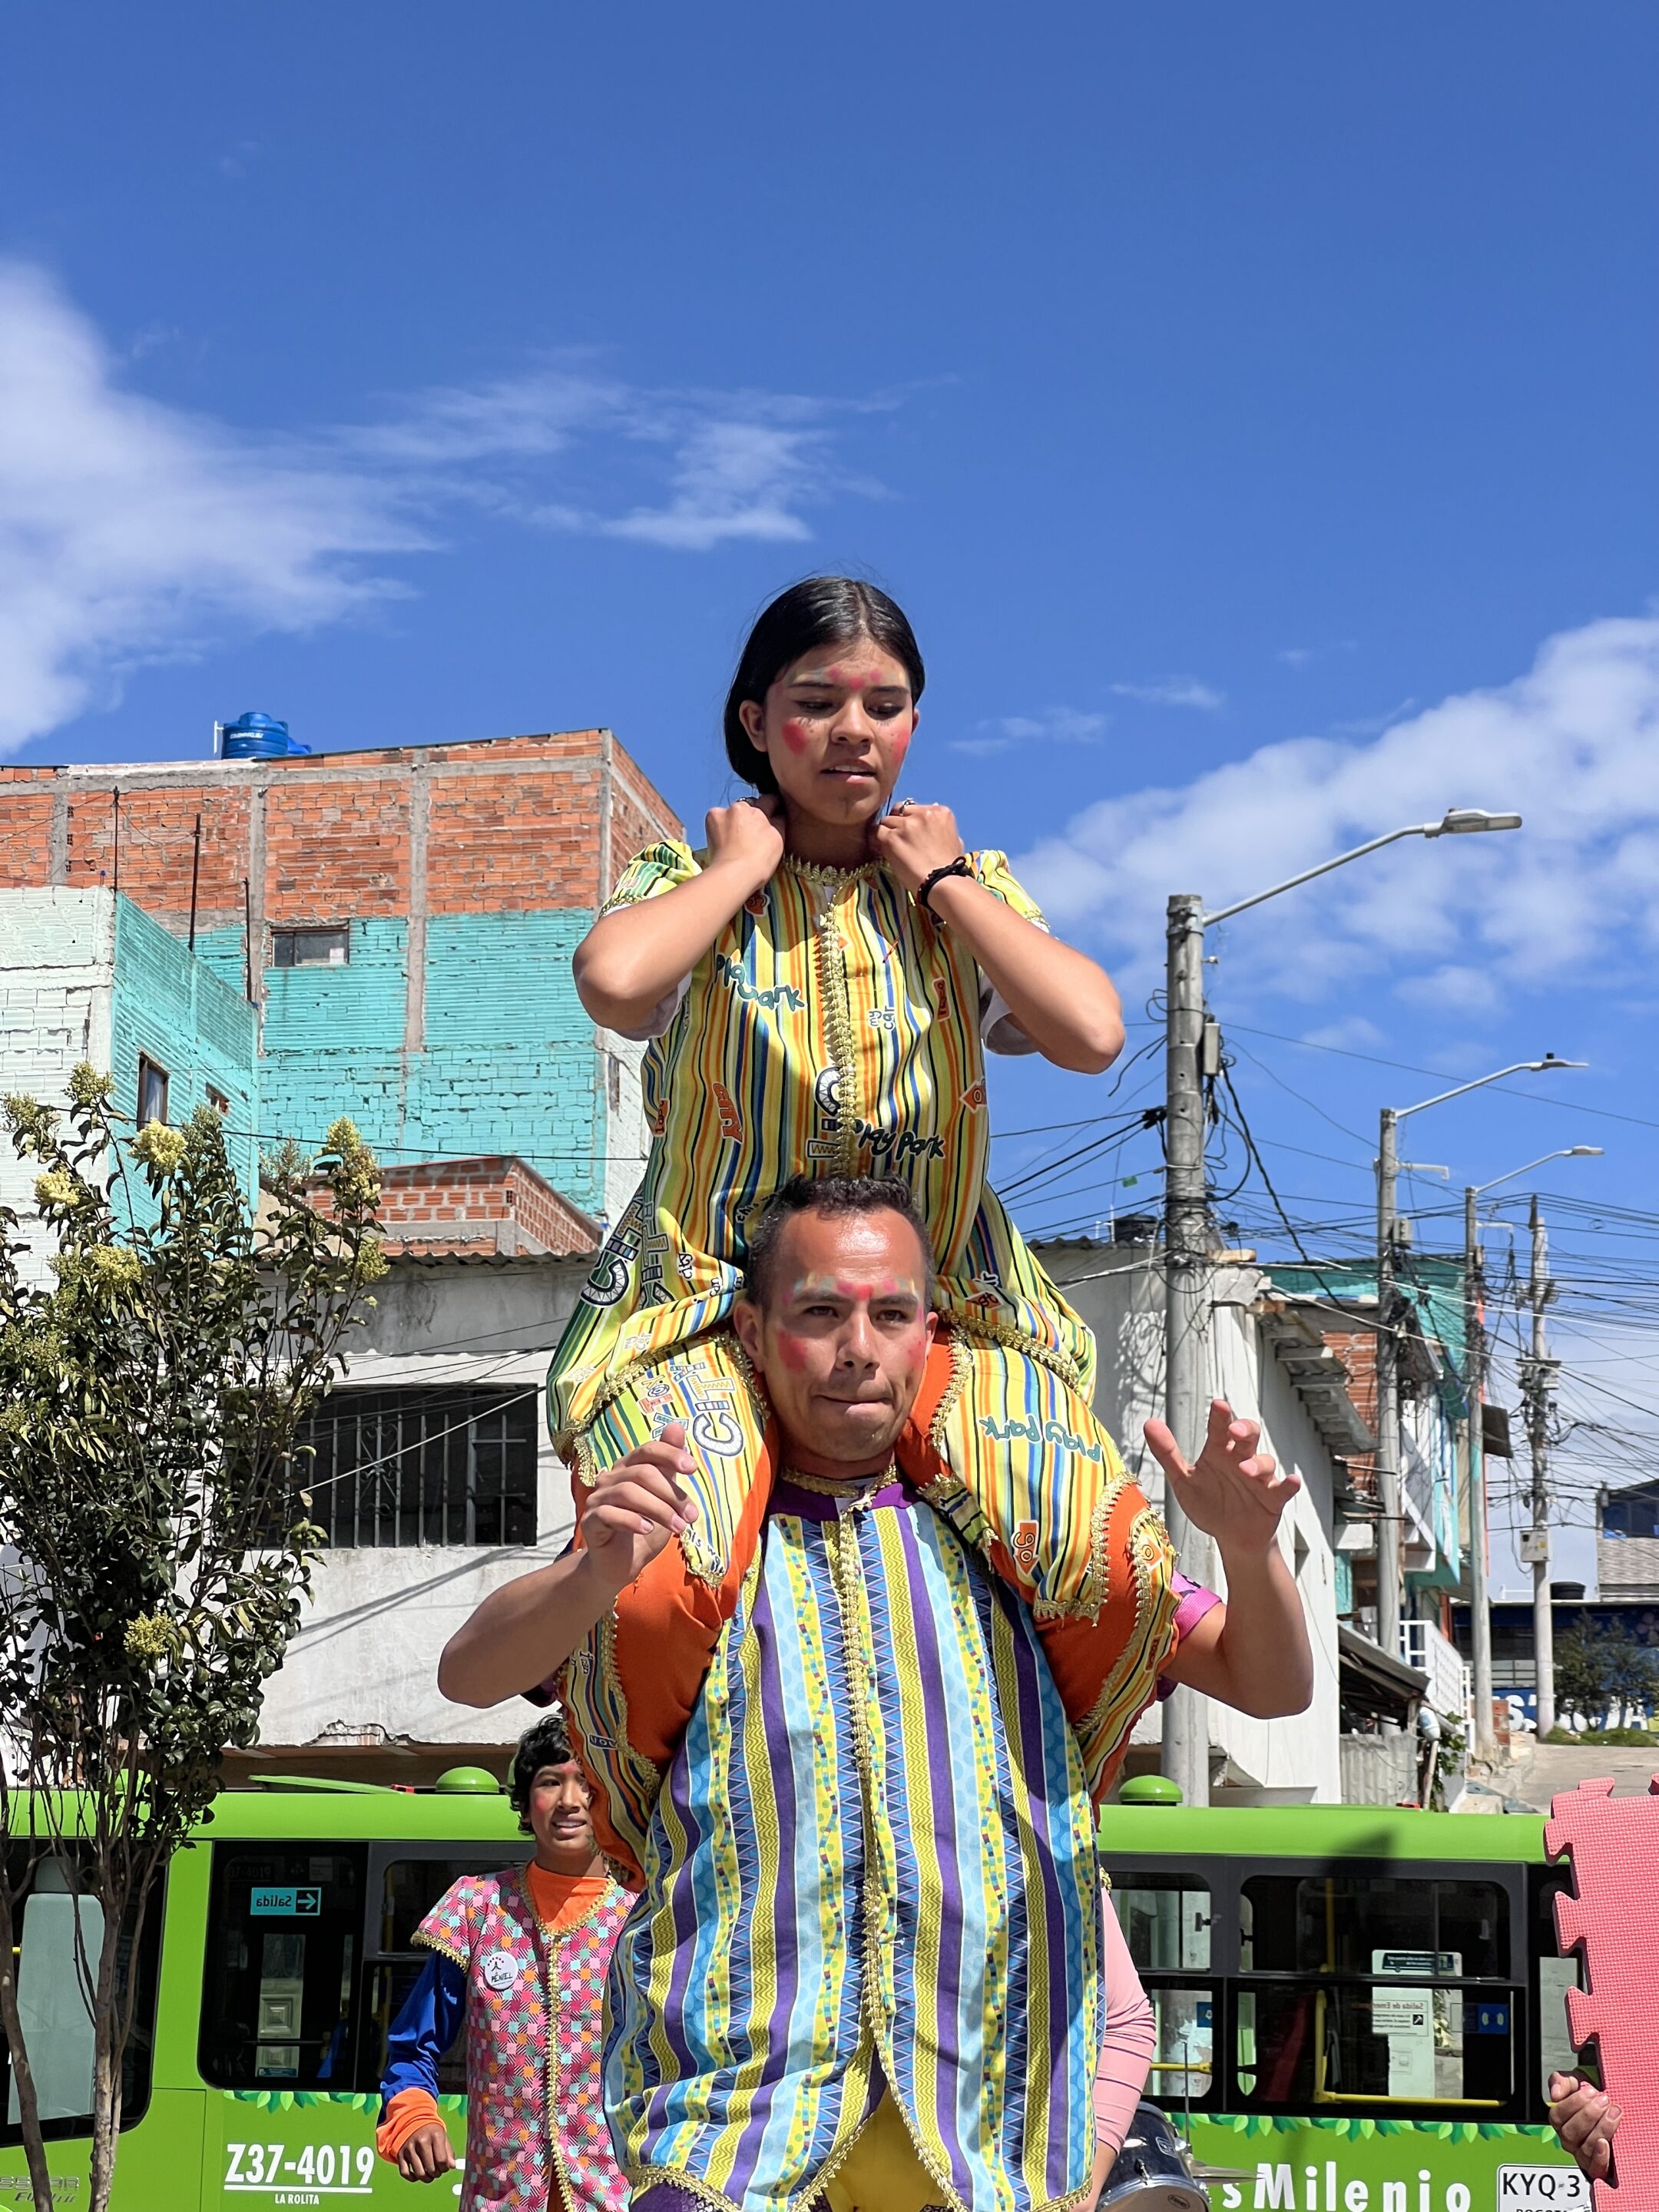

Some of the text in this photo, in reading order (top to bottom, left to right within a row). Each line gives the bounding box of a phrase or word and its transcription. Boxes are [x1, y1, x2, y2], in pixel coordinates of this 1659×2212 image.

[757, 985, 806, 1012] ark
[869, 1010, 882, 1026] my
[883, 1006, 895, 1030] car
[713, 1083, 743, 1143] CITY
[581, 1195, 647, 1306] CIT
[678, 1253, 694, 1279] city
[639, 1374, 673, 1413] TOY
[670, 1362, 743, 1456] CITY
[1045, 1421, 1101, 1462] Play
[1013, 1532, 1035, 1562] go
[229, 1866, 271, 1878] 37-4019
[225, 2144, 375, 2185] Z37-4019
[275, 2193, 320, 2205] LA ROLITA
